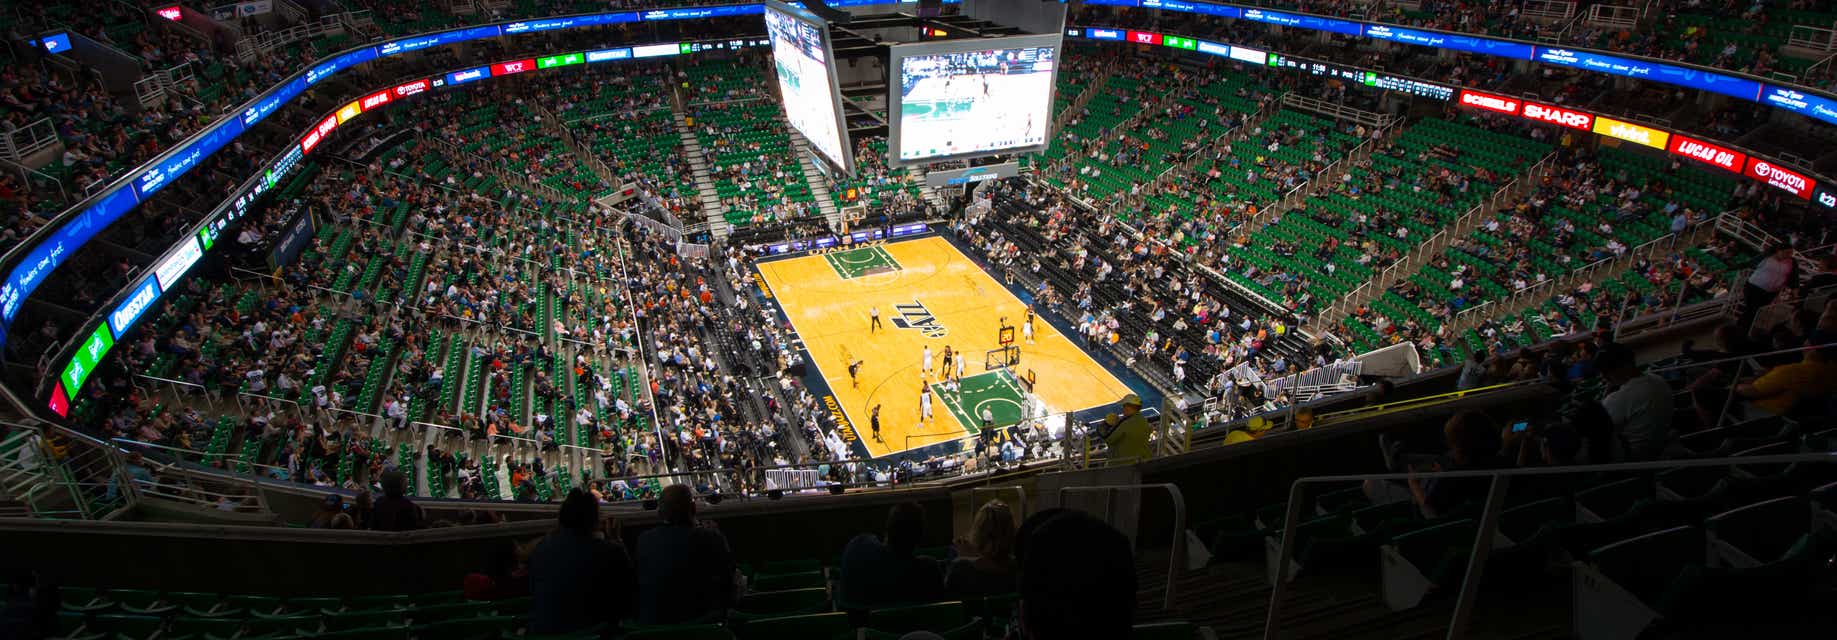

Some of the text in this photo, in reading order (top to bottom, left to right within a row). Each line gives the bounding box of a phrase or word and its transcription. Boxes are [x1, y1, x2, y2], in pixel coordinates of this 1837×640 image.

[1678, 140, 1735, 167] LUCAS OIL
[1770, 167, 1805, 191] TOYOTA
